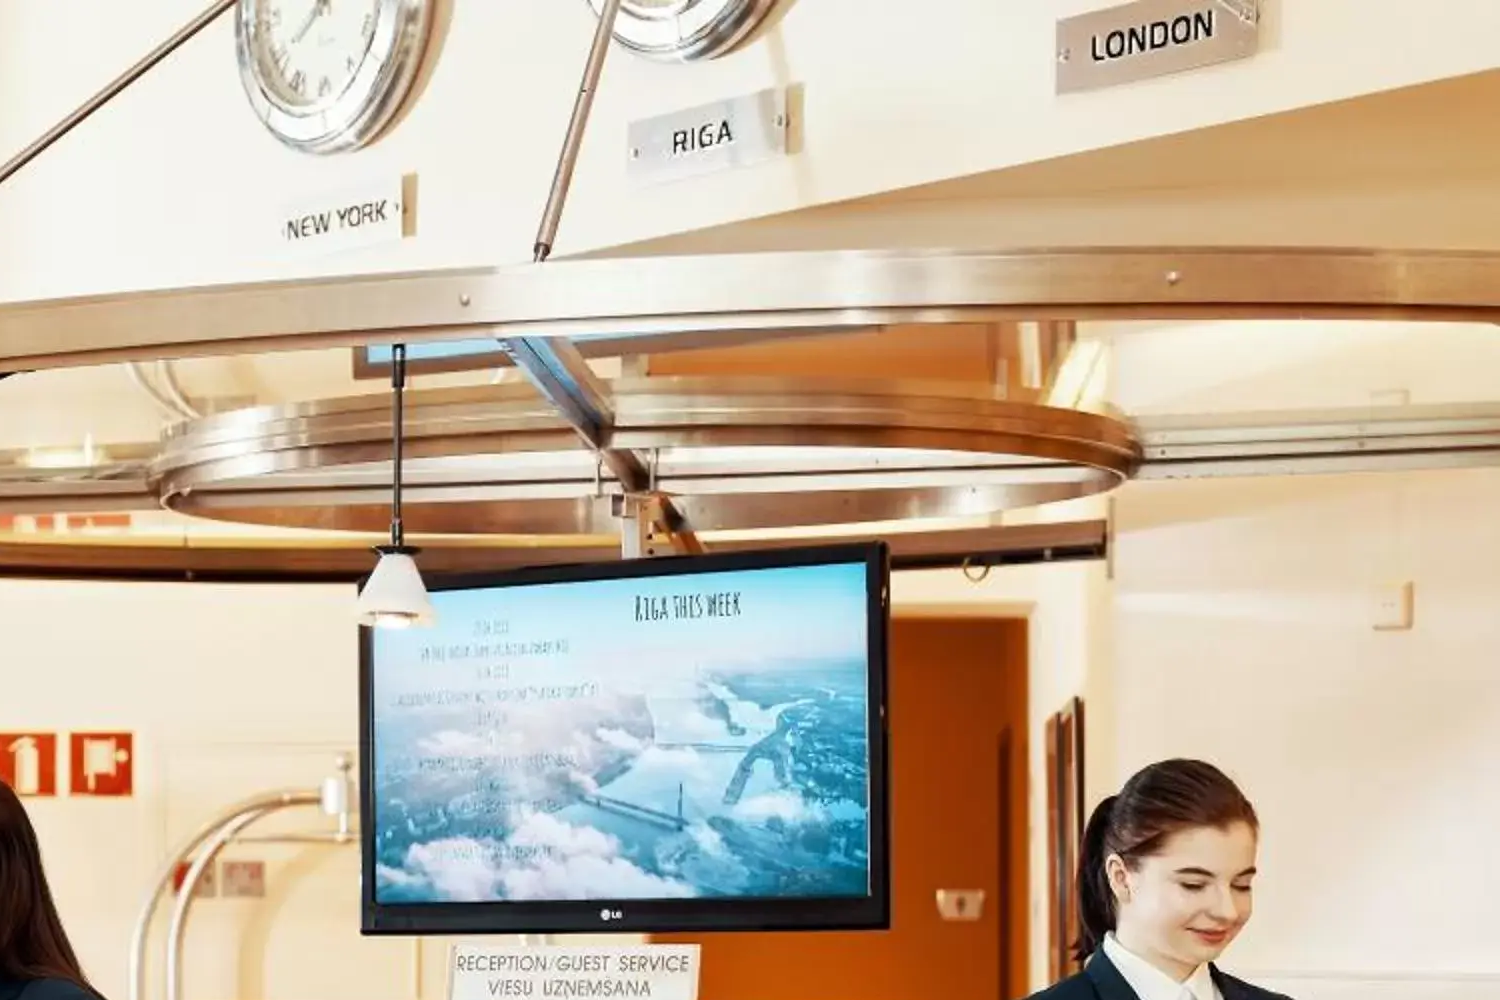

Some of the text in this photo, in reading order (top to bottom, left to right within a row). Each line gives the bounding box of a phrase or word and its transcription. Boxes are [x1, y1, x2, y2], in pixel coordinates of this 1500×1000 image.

[1091, 9, 1213, 61] LONDON
[673, 120, 733, 154] RIGA
[287, 200, 387, 240] NEW YORK
[635, 592, 741, 621] RIGA THIS WEEK
[619, 954, 689, 972] SERVICE
[488, 979, 533, 996] VIESU
